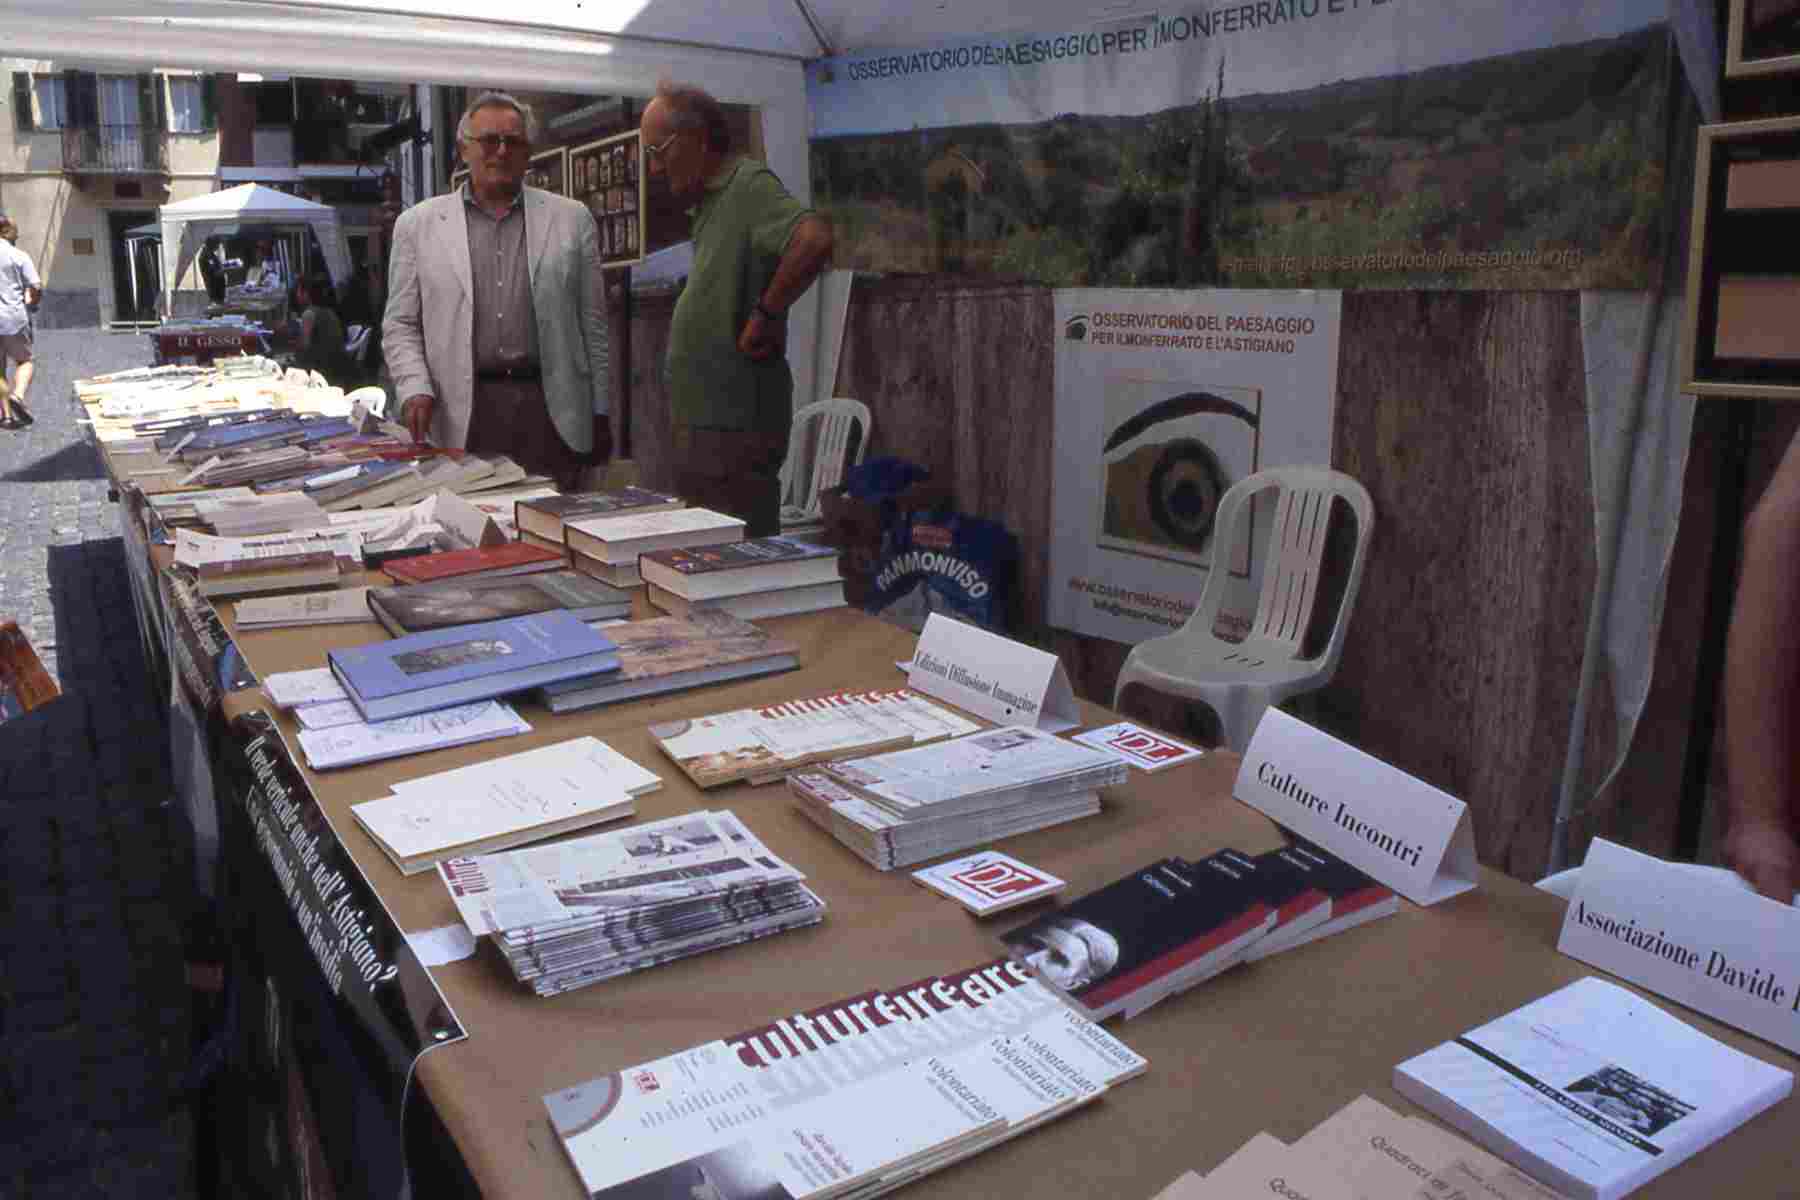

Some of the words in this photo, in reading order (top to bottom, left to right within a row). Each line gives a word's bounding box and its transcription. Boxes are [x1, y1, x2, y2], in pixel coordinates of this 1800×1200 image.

[848, 47, 969, 81] OSSERVATORIO
[1101, 28, 1147, 55] PER
[197, 335, 241, 348] GESSO
[1091, 331, 1114, 346] PER
[1126, 333, 1202, 350] MONFERRATO
[1205, 336, 1213, 350] E
[1216, 337, 1295, 354] L'ASTIGIANO
[1092, 312, 1193, 330] OSSERVATORIO
[1196, 315, 1222, 331] DEL
[1226, 315, 1315, 334] PAESAGGIO
[1257, 761, 1329, 816] Culture
[1332, 801, 1424, 868] Incontri
[1571, 900, 1700, 970] Associazione
[1705, 949, 1785, 1004] Davide
[927, 1056, 998, 1121] volontariato
[990, 1036, 1066, 1099] volontariato
[1021, 1032, 1098, 1094] volontariato
